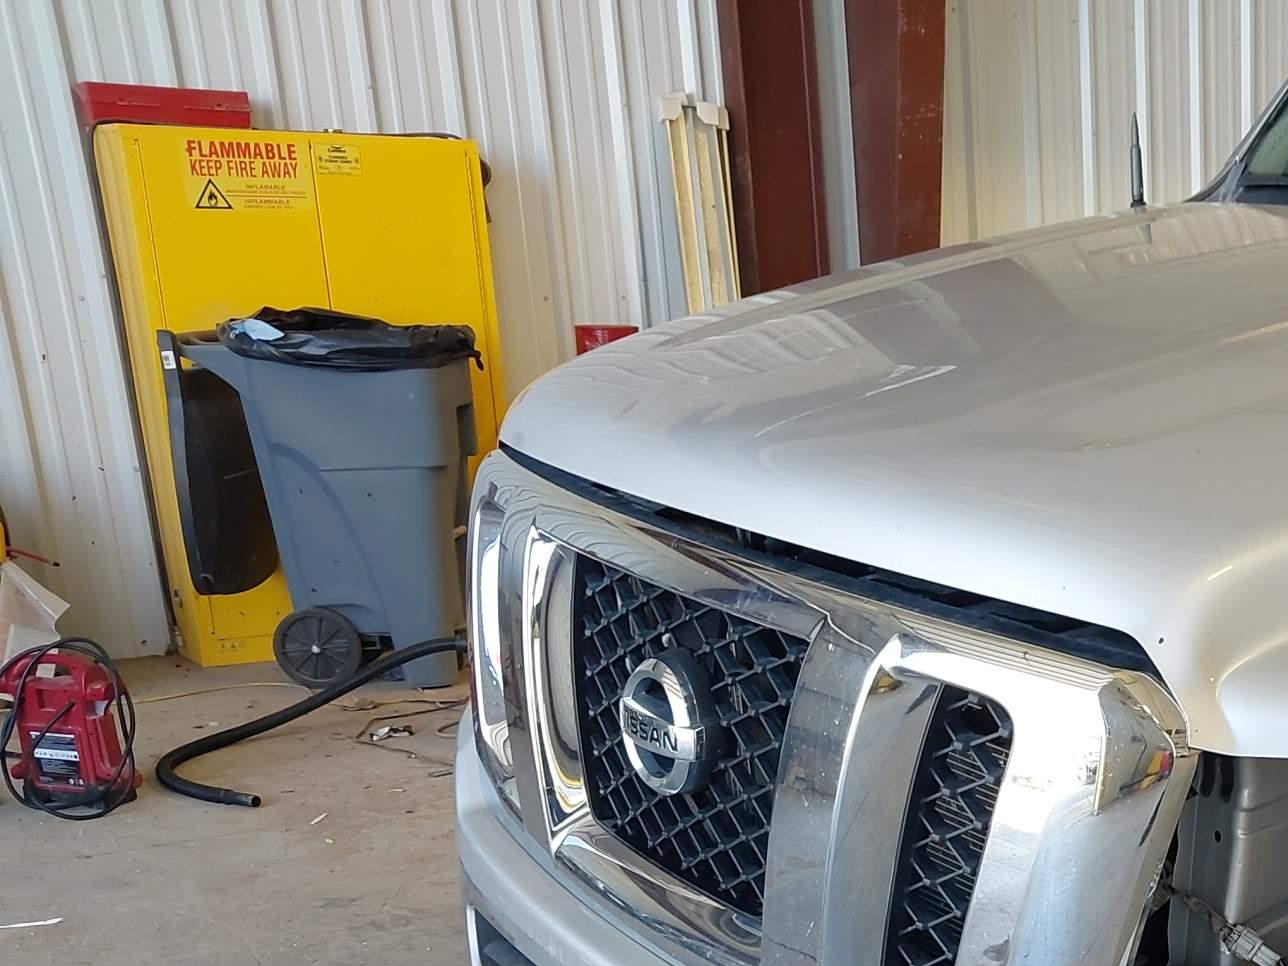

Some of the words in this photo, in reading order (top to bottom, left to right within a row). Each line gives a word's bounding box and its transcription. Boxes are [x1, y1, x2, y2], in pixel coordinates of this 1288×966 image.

[186, 140, 298, 160] FLAMMABLE
[190, 159, 222, 177] KEEP
[227, 160, 257, 178] FIRE
[261, 161, 298, 179] AWAY
[624, 709, 680, 753] ISSAN
